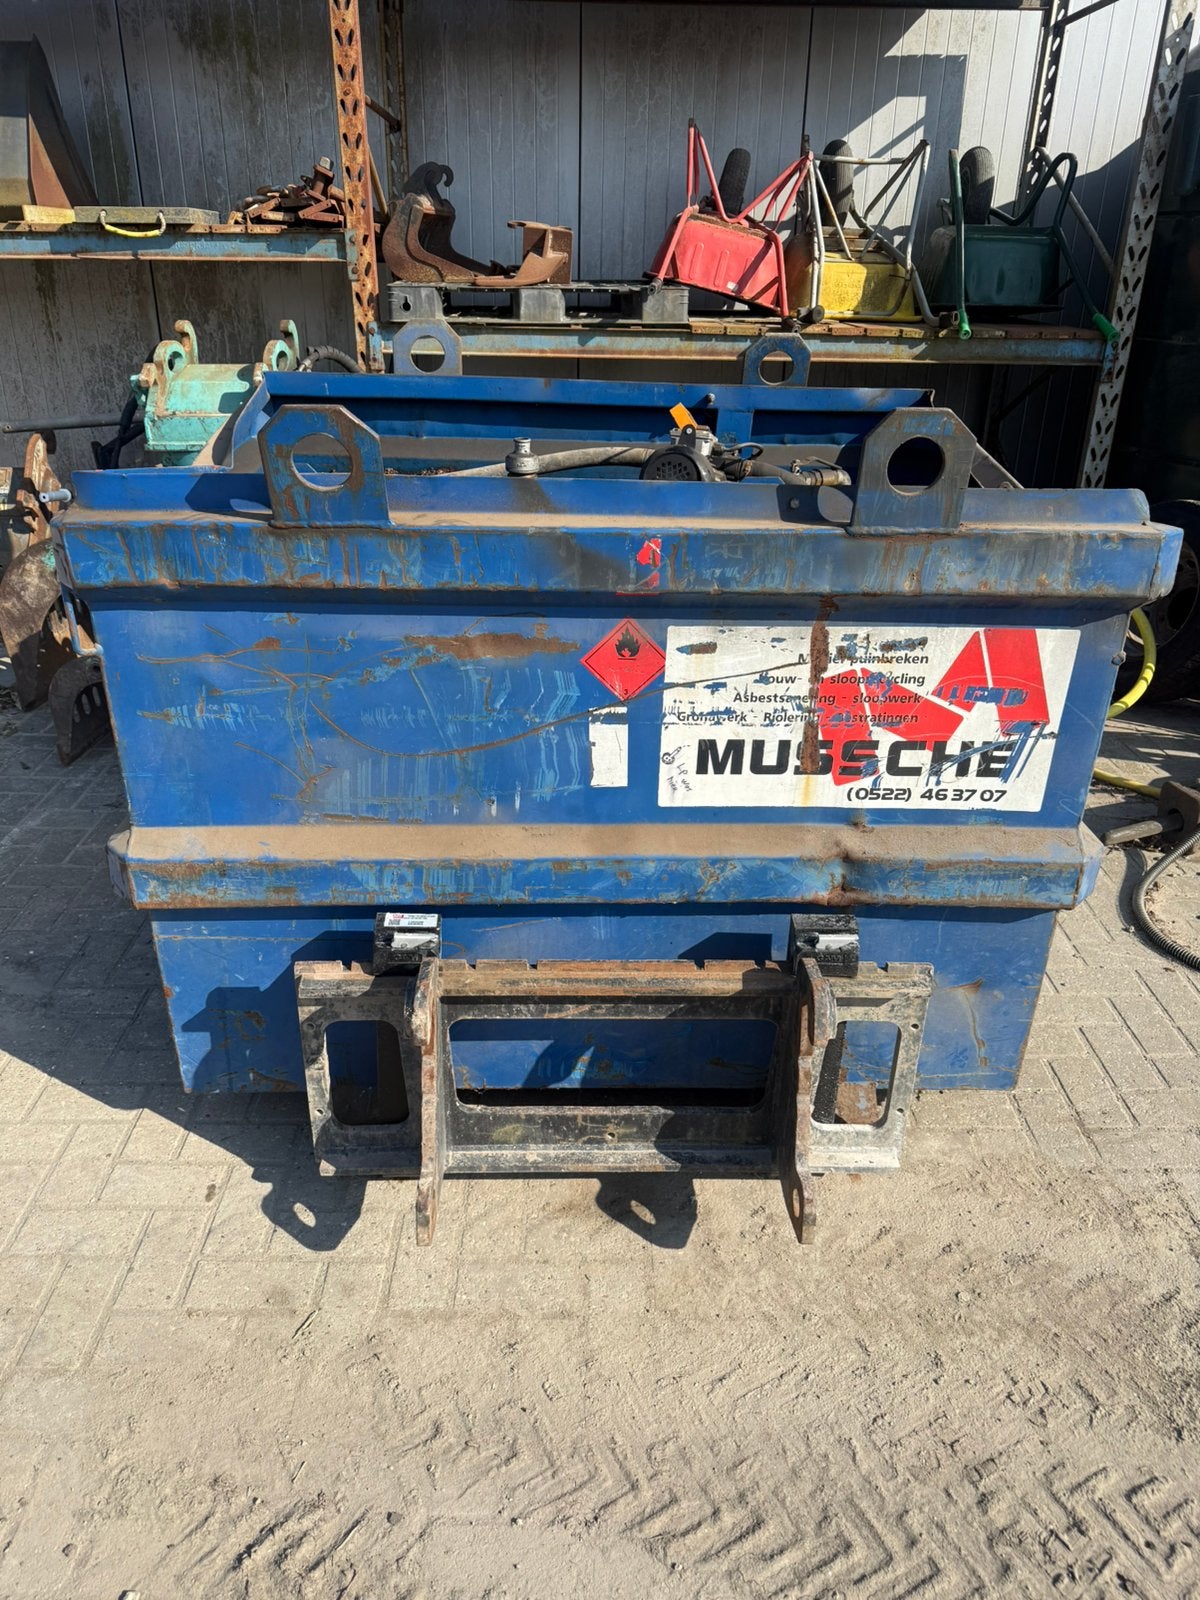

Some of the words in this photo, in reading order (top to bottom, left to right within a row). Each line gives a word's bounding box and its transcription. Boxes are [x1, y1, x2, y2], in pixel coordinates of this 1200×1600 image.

[849, 653, 929, 667] puinbreken
[761, 672, 802, 684] ouw-
[763, 711, 820, 724] Riolerin
[834, 712, 918, 725] stratingen
[695, 738, 1016, 777] MUSSCHE
[846, 786, 912, 802] (0522)
